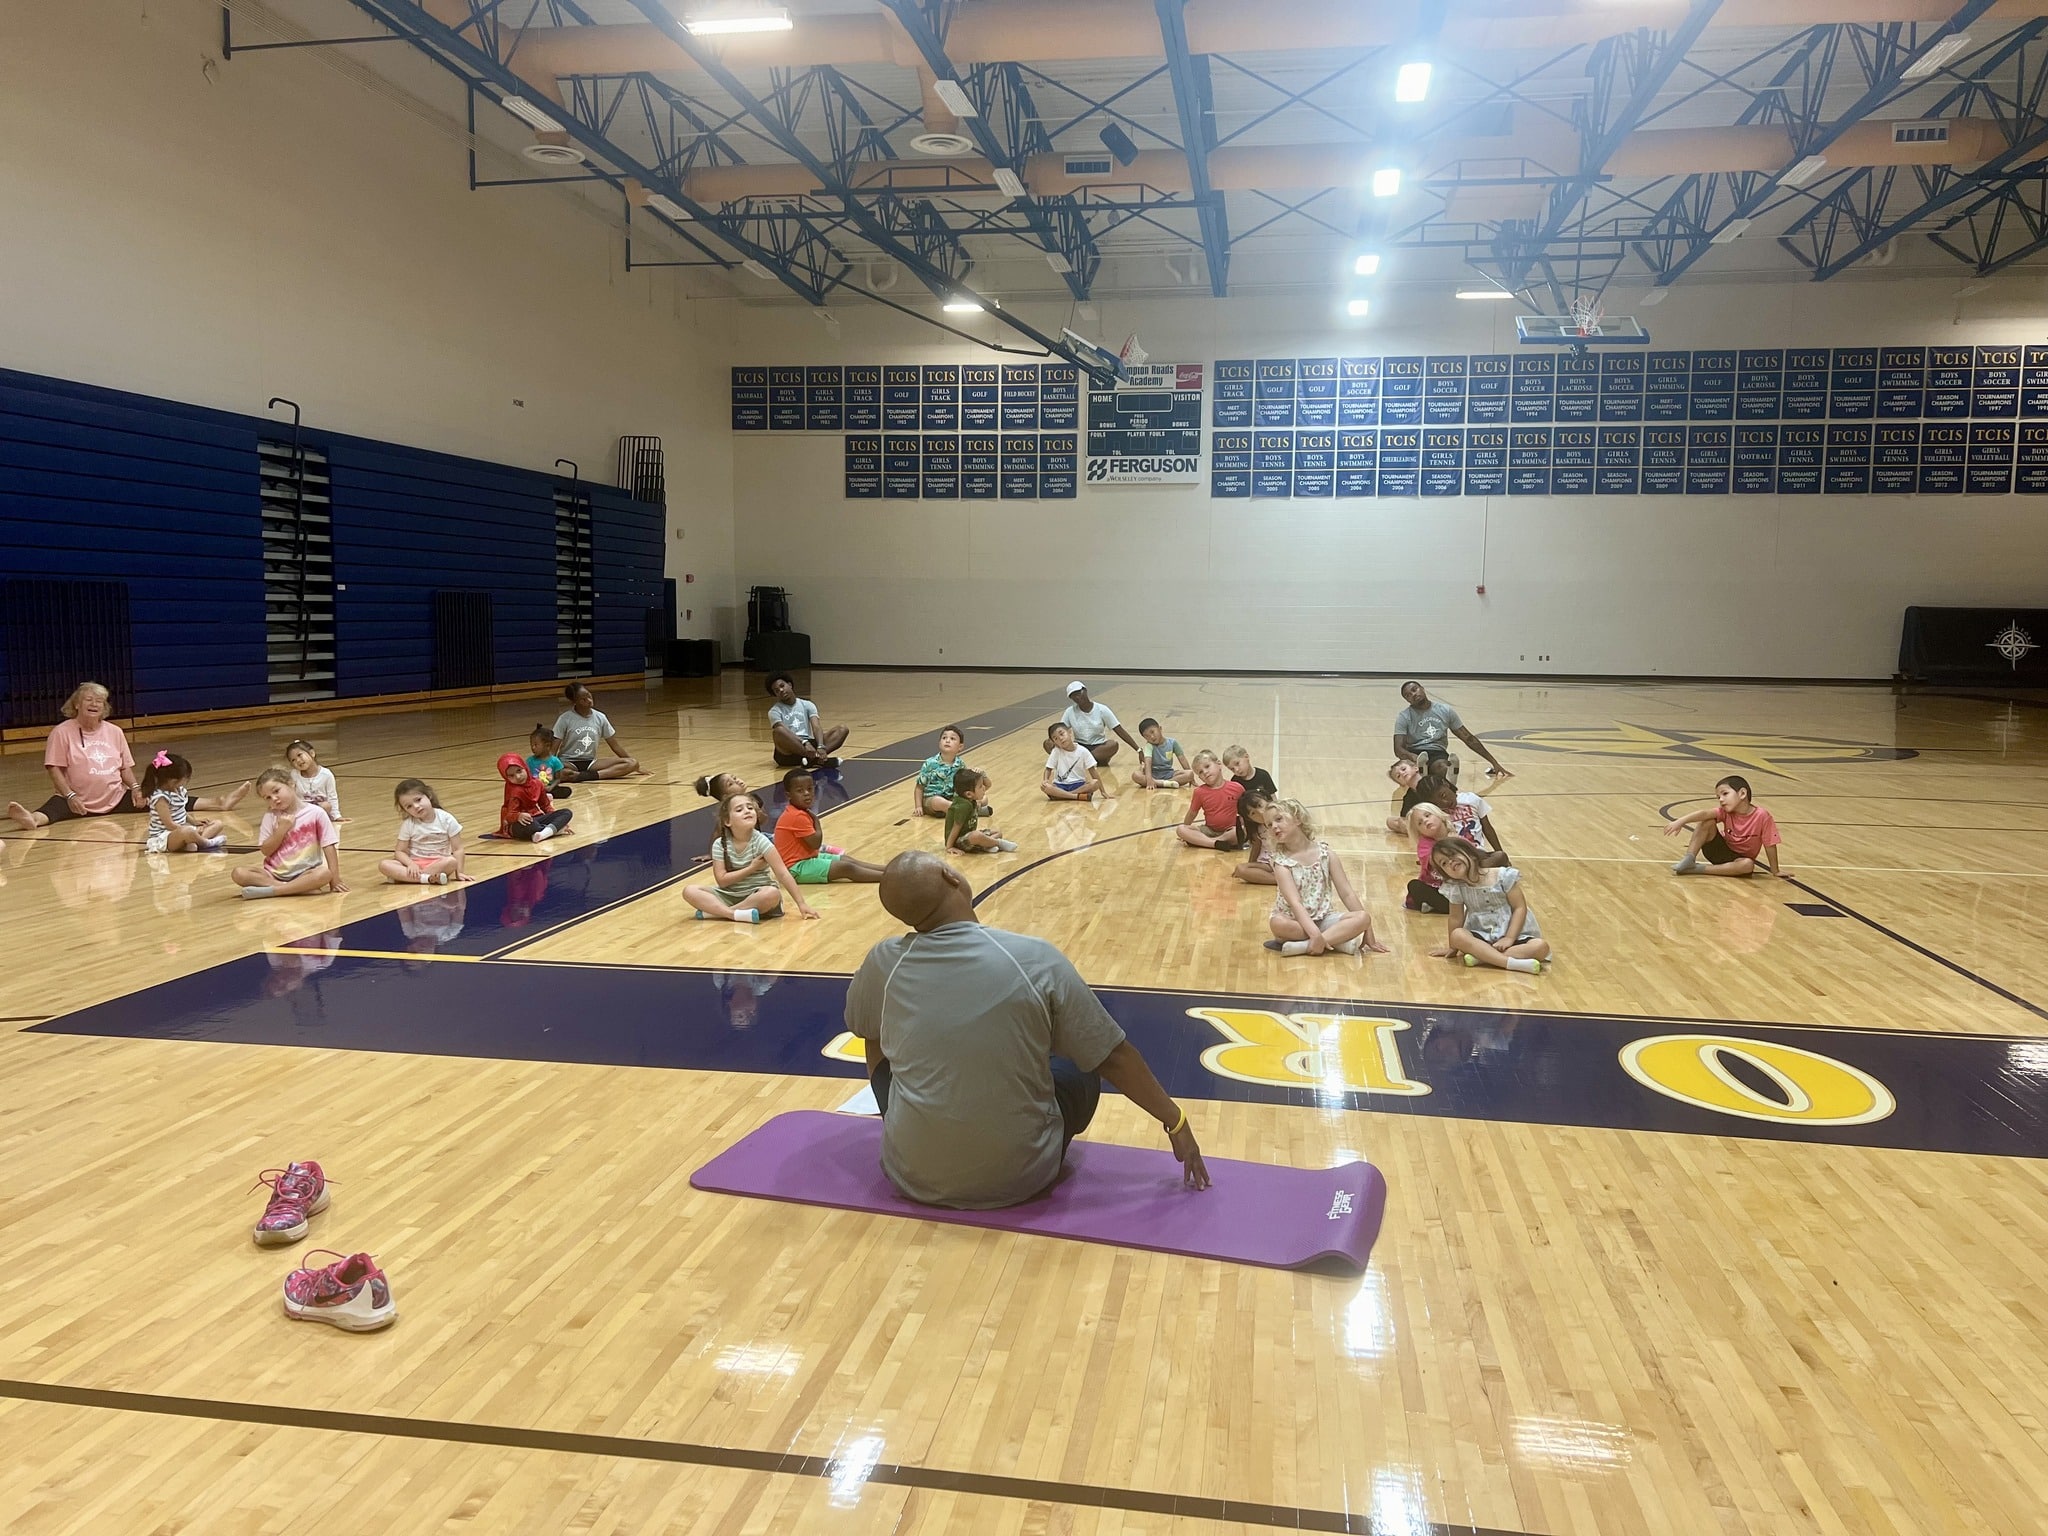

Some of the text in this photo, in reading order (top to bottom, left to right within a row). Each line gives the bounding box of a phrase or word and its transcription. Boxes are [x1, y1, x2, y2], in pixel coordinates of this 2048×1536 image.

[1698, 357, 1732, 368] TCIS
[1745, 356, 1778, 368] TCIS
[1792, 356, 1825, 367] TCIS
[1839, 355, 1872, 366] TCIS
[1887, 354, 1920, 365] TCIS
[1934, 353, 1969, 364] TCIS
[1982, 352, 2017, 364] TCIS
[1389, 363, 1419, 374] TCIS
[1432, 362, 1462, 373] TCIS
[1475, 362, 1507, 372] TCIS
[1519, 361, 1550, 371] TCIS
[1563, 360, 1595, 371] TCIS
[1608, 359, 1640, 370] TCIS
[1653, 358, 1686, 369] TCIS
[1152, 365, 1174, 374] Roads
[1220, 367, 1250, 377] TCIS
[1262, 366, 1291, 376] TCIS
[1303, 365, 1334, 375] TCIS
[1346, 364, 1376, 375] TCIS
[737, 373, 764, 383] TCIS
[773, 373, 800, 383] TCIS
[811, 372, 839, 382] TCIS
[850, 372, 877, 382] TCIS
[888, 372, 916, 382] TCIS
[928, 371, 955, 381] TCIS
[967, 371, 995, 381] TCIS
[1006, 370, 1035, 380] TCIS
[1046, 370, 1074, 380] TCIS
[1130, 377, 1163, 386] Academy
[1472, 434, 1503, 445] TCIS
[1516, 433, 1547, 444] TCIS
[1559, 433, 1591, 444] TCIS
[1604, 433, 1636, 444] TCIS
[1649, 432, 1681, 443] TCIS
[1694, 432, 1727, 443] TCIS
[1740, 432, 1773, 443] TCIS
[1786, 431, 1820, 442] TCIS
[1833, 431, 1867, 442] TCIS
[1882, 430, 1915, 441] TCIS
[1929, 430, 1962, 441] TCIS
[1976, 429, 2010, 440] TCIS
[888, 440, 916, 450] TCIS
[966, 440, 994, 450] TCIS
[1006, 440, 1034, 450] TCIS
[1045, 440, 1073, 450] TCIS
[1218, 438, 1248, 448] TCIS
[1260, 437, 1289, 447] TCIS
[1301, 437, 1331, 447] TCIS
[1343, 436, 1373, 446] TCIS
[1385, 435, 1416, 446] TCIS
[1428, 435, 1459, 445] TCIS
[850, 441, 878, 450] TCIS
[927, 441, 955, 450] TCIS
[1110, 458, 1197, 473] FERGUSON
